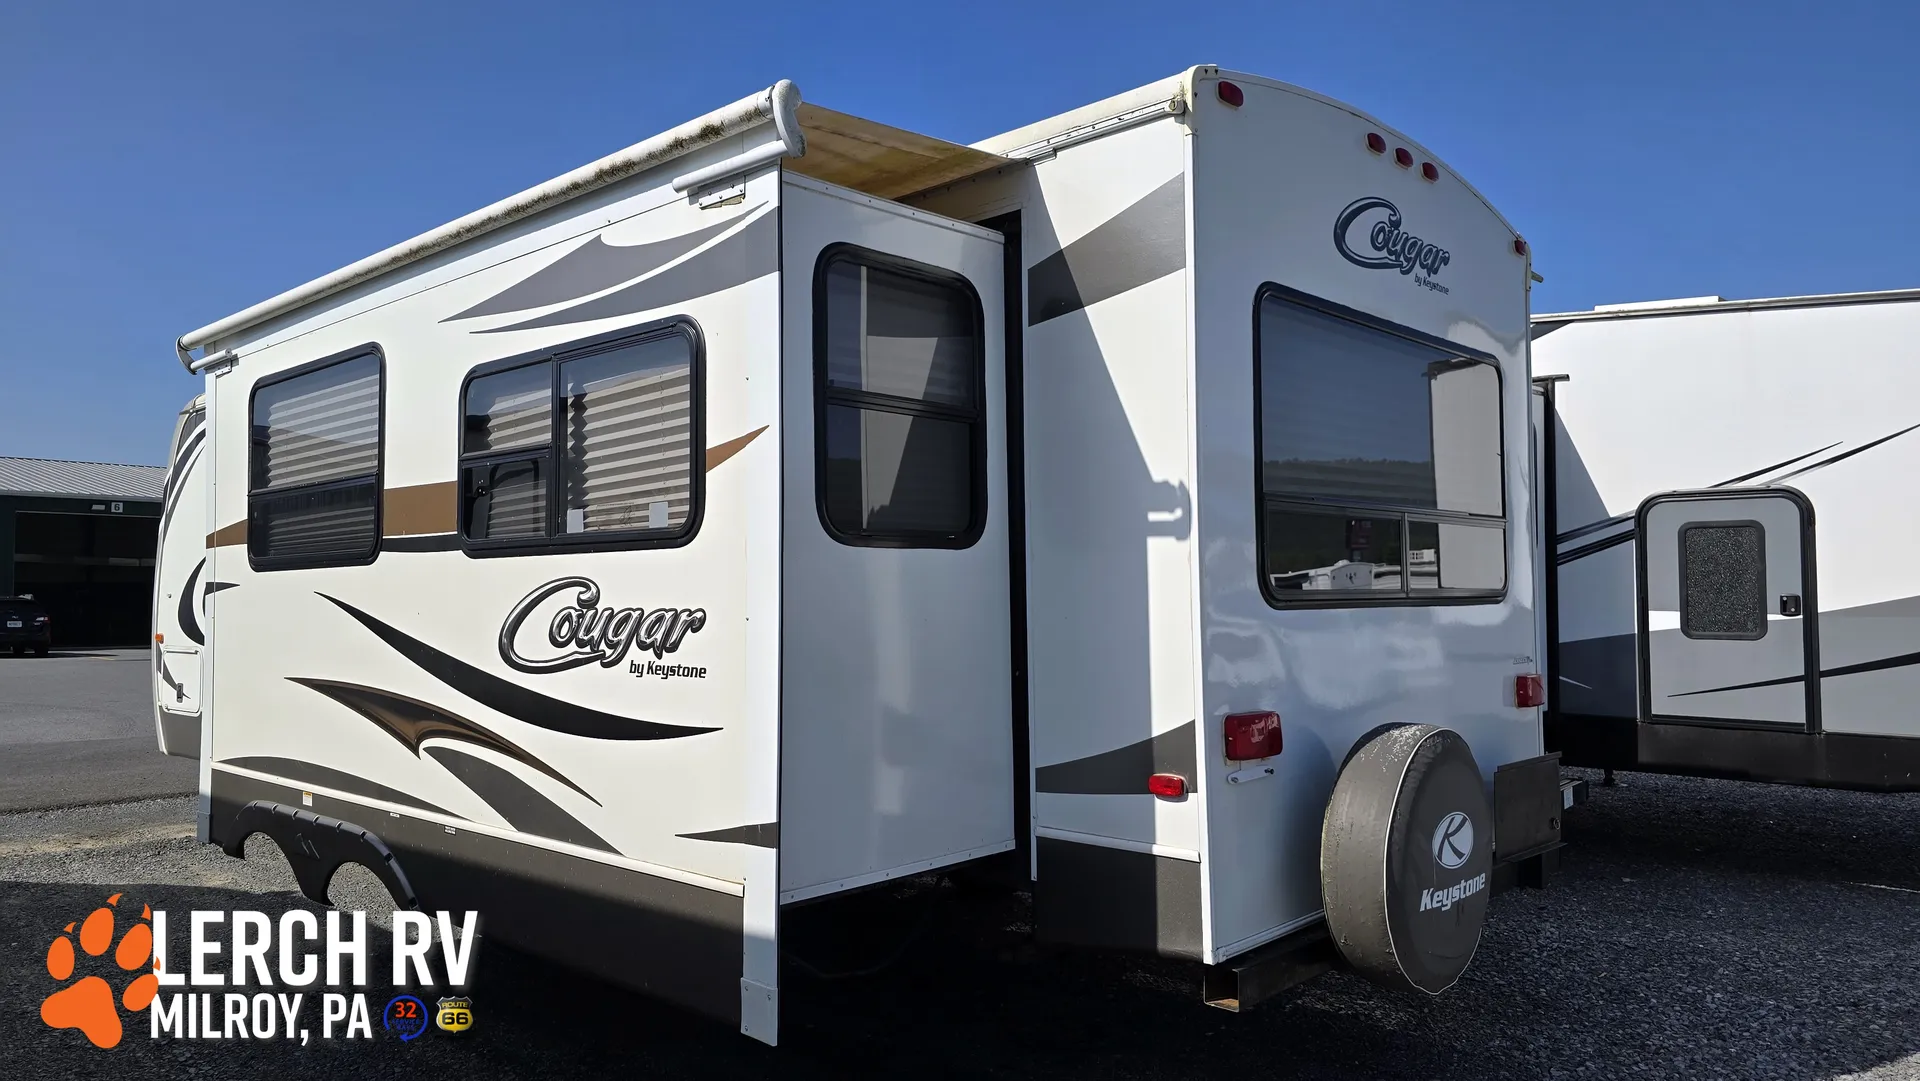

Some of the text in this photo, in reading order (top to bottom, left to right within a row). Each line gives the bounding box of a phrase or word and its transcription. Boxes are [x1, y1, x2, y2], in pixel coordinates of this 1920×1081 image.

[1333, 196, 1450, 278] Cougar
[1414, 273, 1449, 295] by Keystone
[498, 576, 706, 674] Cougar
[629, 660, 707, 679] by Keystone
[1420, 873, 1486, 912] Keystone
